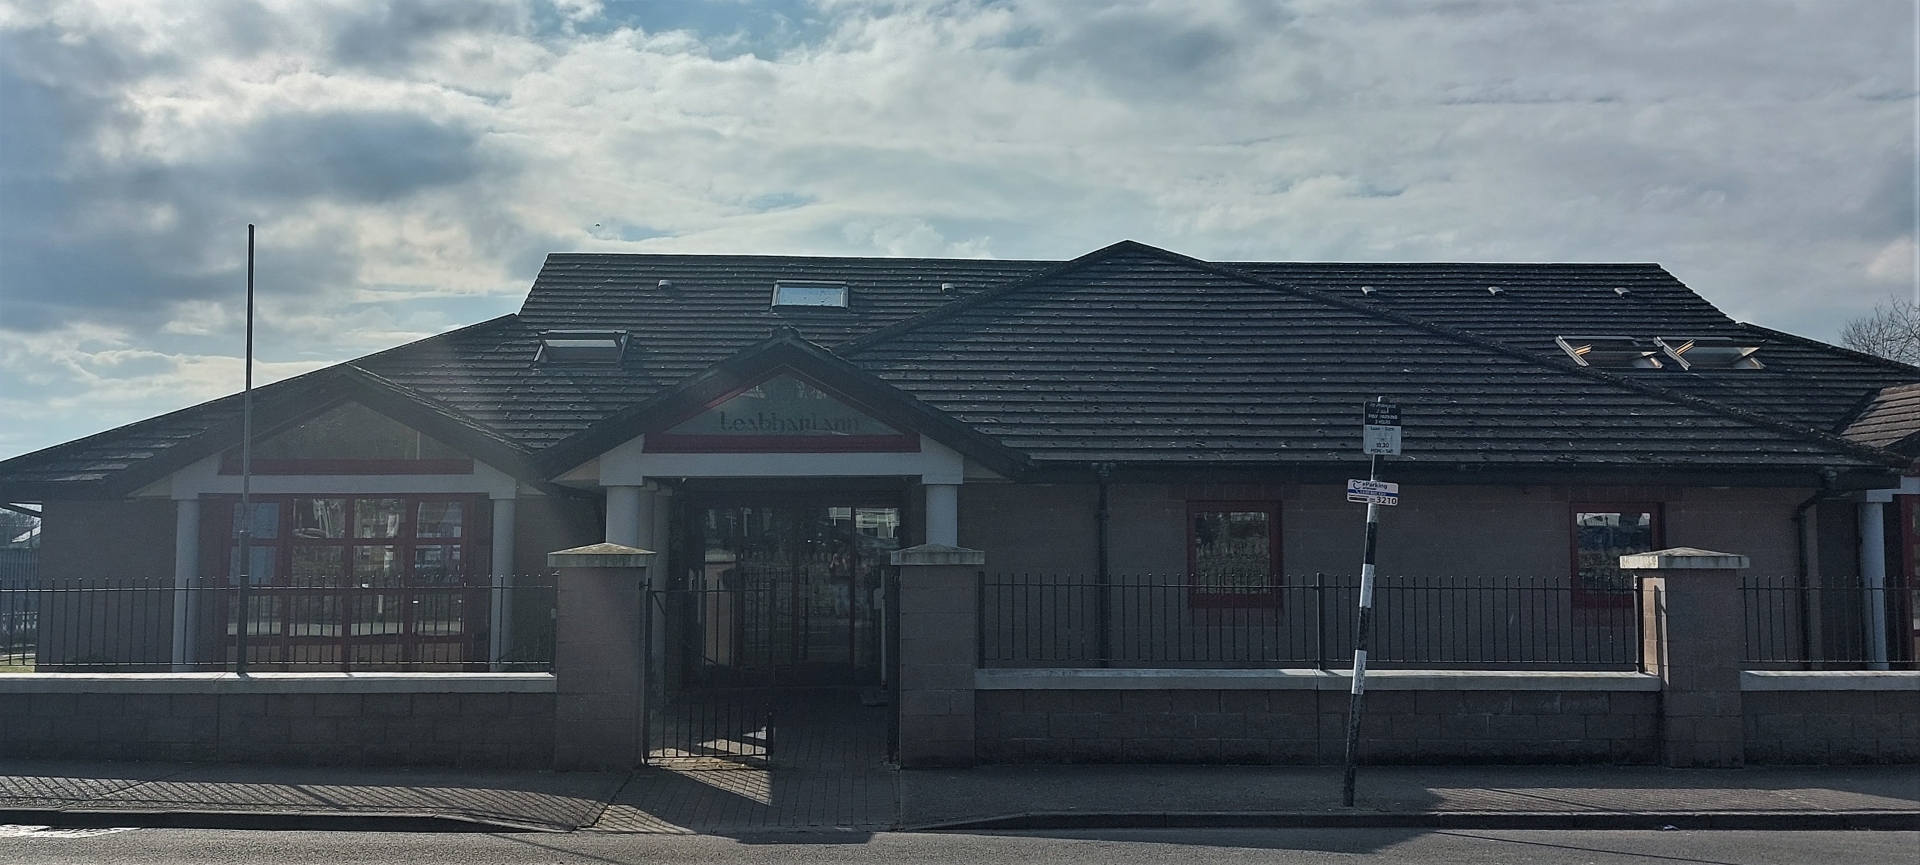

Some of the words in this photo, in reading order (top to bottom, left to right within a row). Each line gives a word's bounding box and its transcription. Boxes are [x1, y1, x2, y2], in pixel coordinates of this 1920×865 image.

[719, 411, 860, 432] Leabharlann
[1362, 481, 1388, 489] eParking
[1376, 496, 1397, 505] 3210
